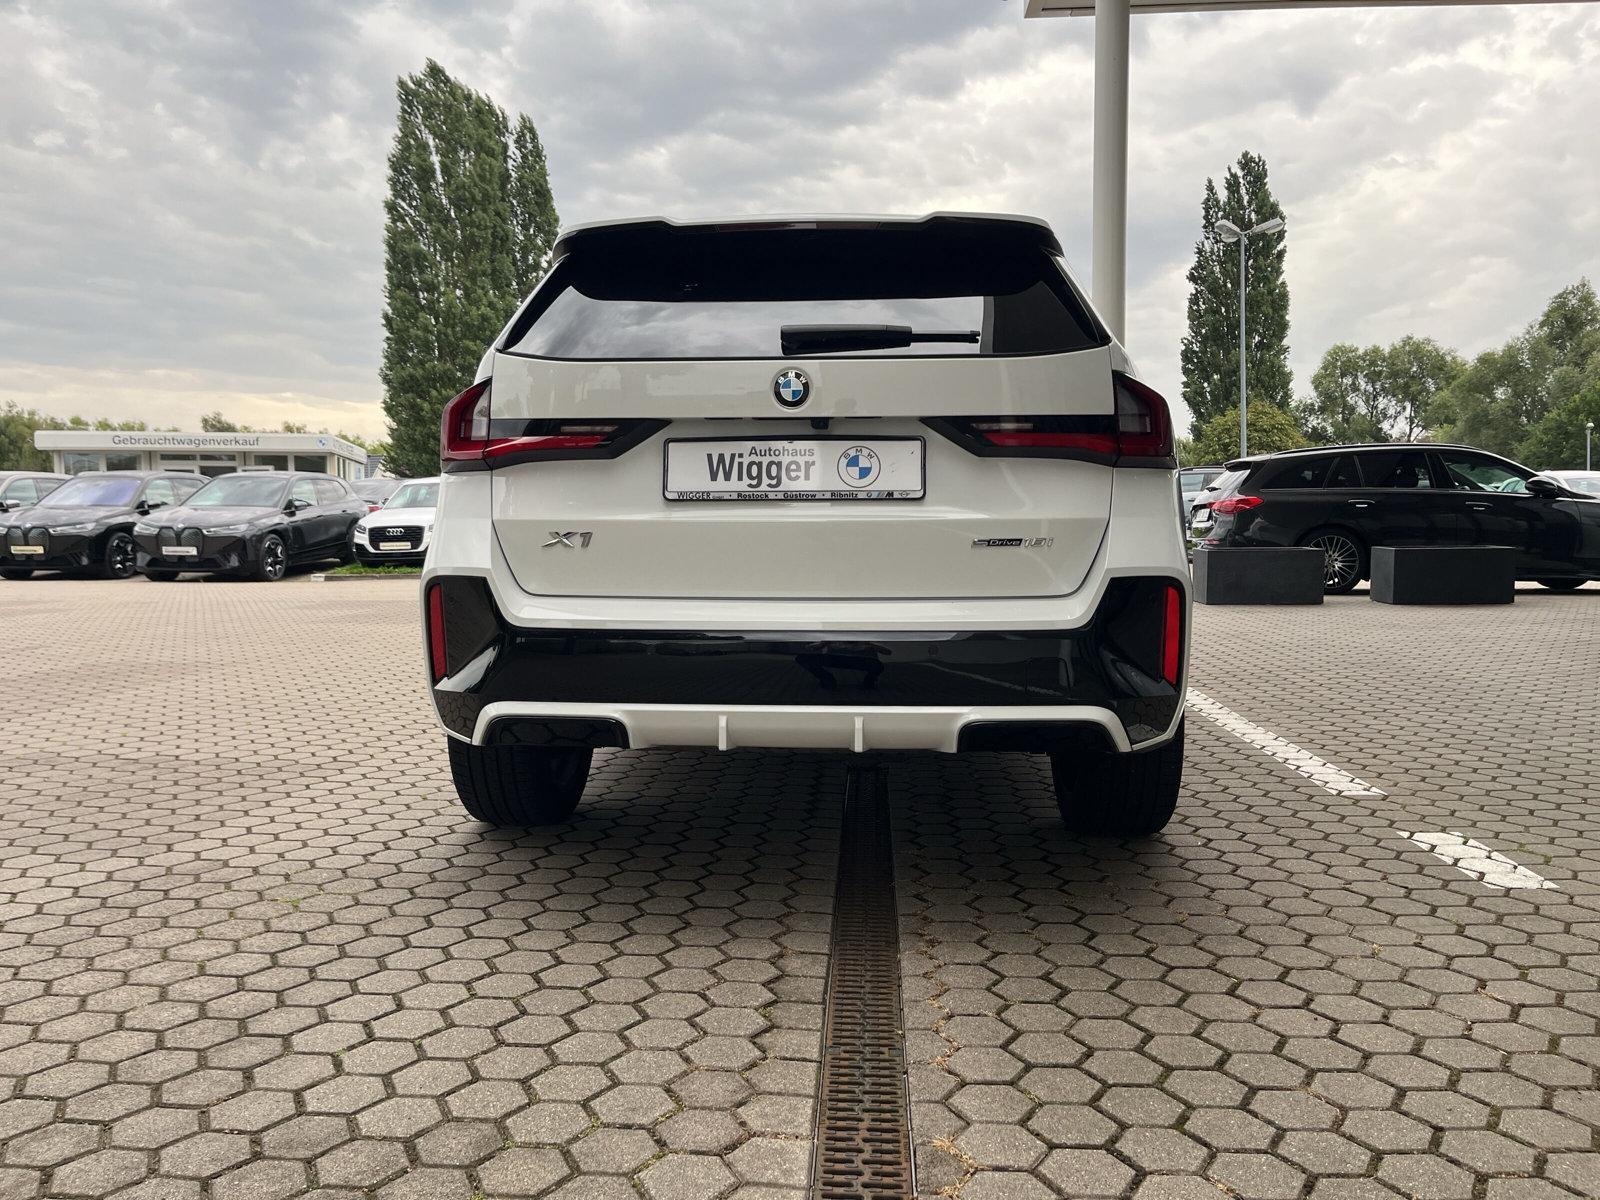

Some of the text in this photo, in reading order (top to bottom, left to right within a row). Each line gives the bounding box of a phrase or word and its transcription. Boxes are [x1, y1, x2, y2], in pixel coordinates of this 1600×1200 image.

[778, 371, 807, 384] BMW
[112, 435, 260, 447] Gebrauchtwagenverkauf
[748, 446, 815, 457] Autohaus
[843, 448, 875, 460] BMW
[706, 453, 816, 489] Wigger
[677, 491, 711, 499] WIGGER
[830, 491, 859, 499] Ribnitz
[541, 531, 594, 547] X1
